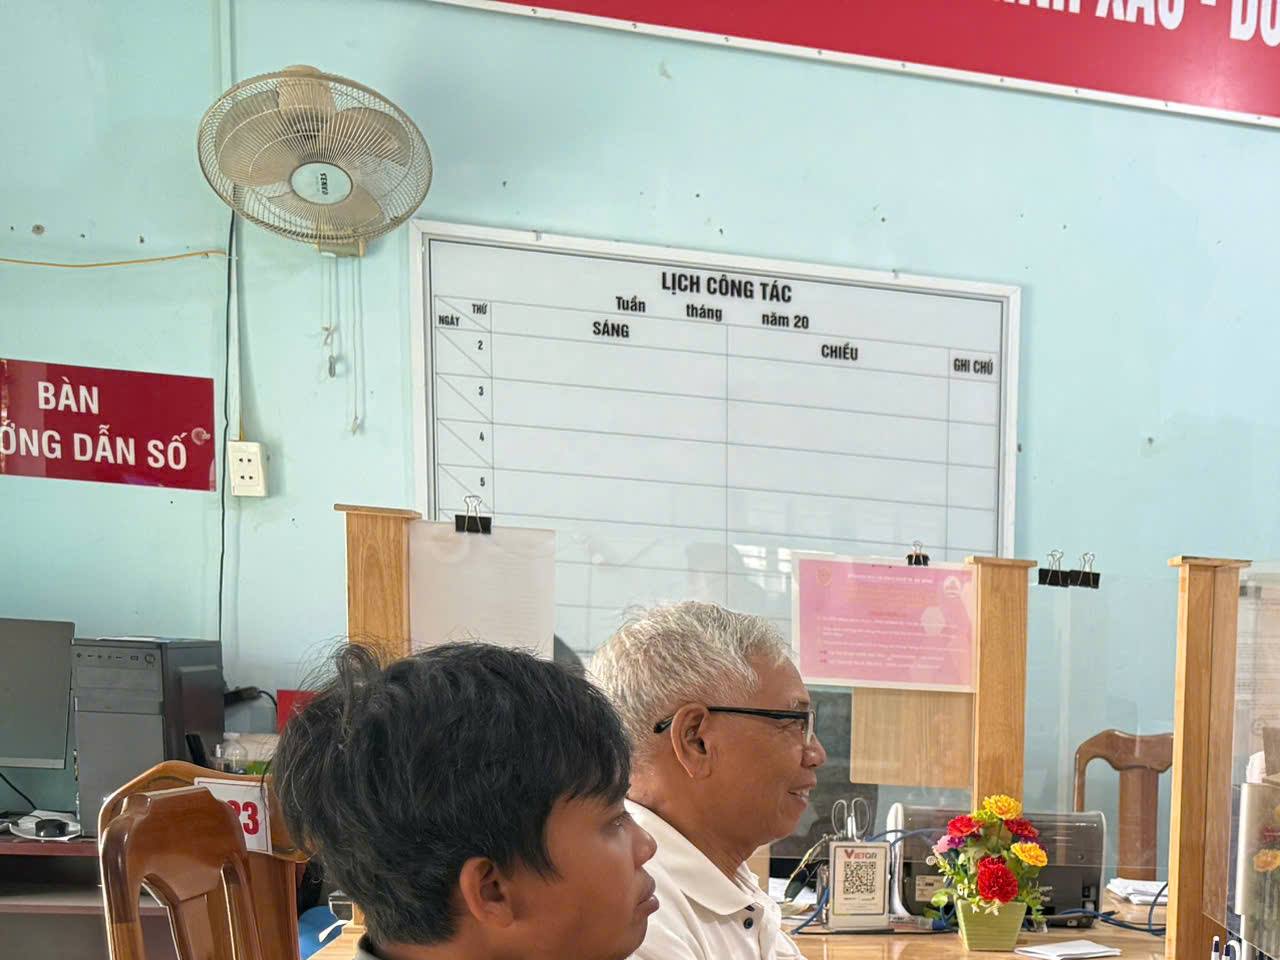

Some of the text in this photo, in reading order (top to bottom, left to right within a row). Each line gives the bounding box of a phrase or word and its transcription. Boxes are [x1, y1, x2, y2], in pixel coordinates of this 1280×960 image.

[662, 272, 793, 303] LỊCH CÔNG TÁC
[616, 296, 809, 329] Tuần tháng năm 20
[593, 320, 629, 338] SÁNG
[478, 340, 483, 350] 2
[954, 358, 994, 376] GHI CHÚ
[38, 376, 99, 415] BÀN
[479, 386, 484, 396] 3
[479, 432, 485, 441] 4
[73, 424, 136, 466] DẪN
[147, 432, 188, 471] SỐ
[480, 477, 485, 487] 5
